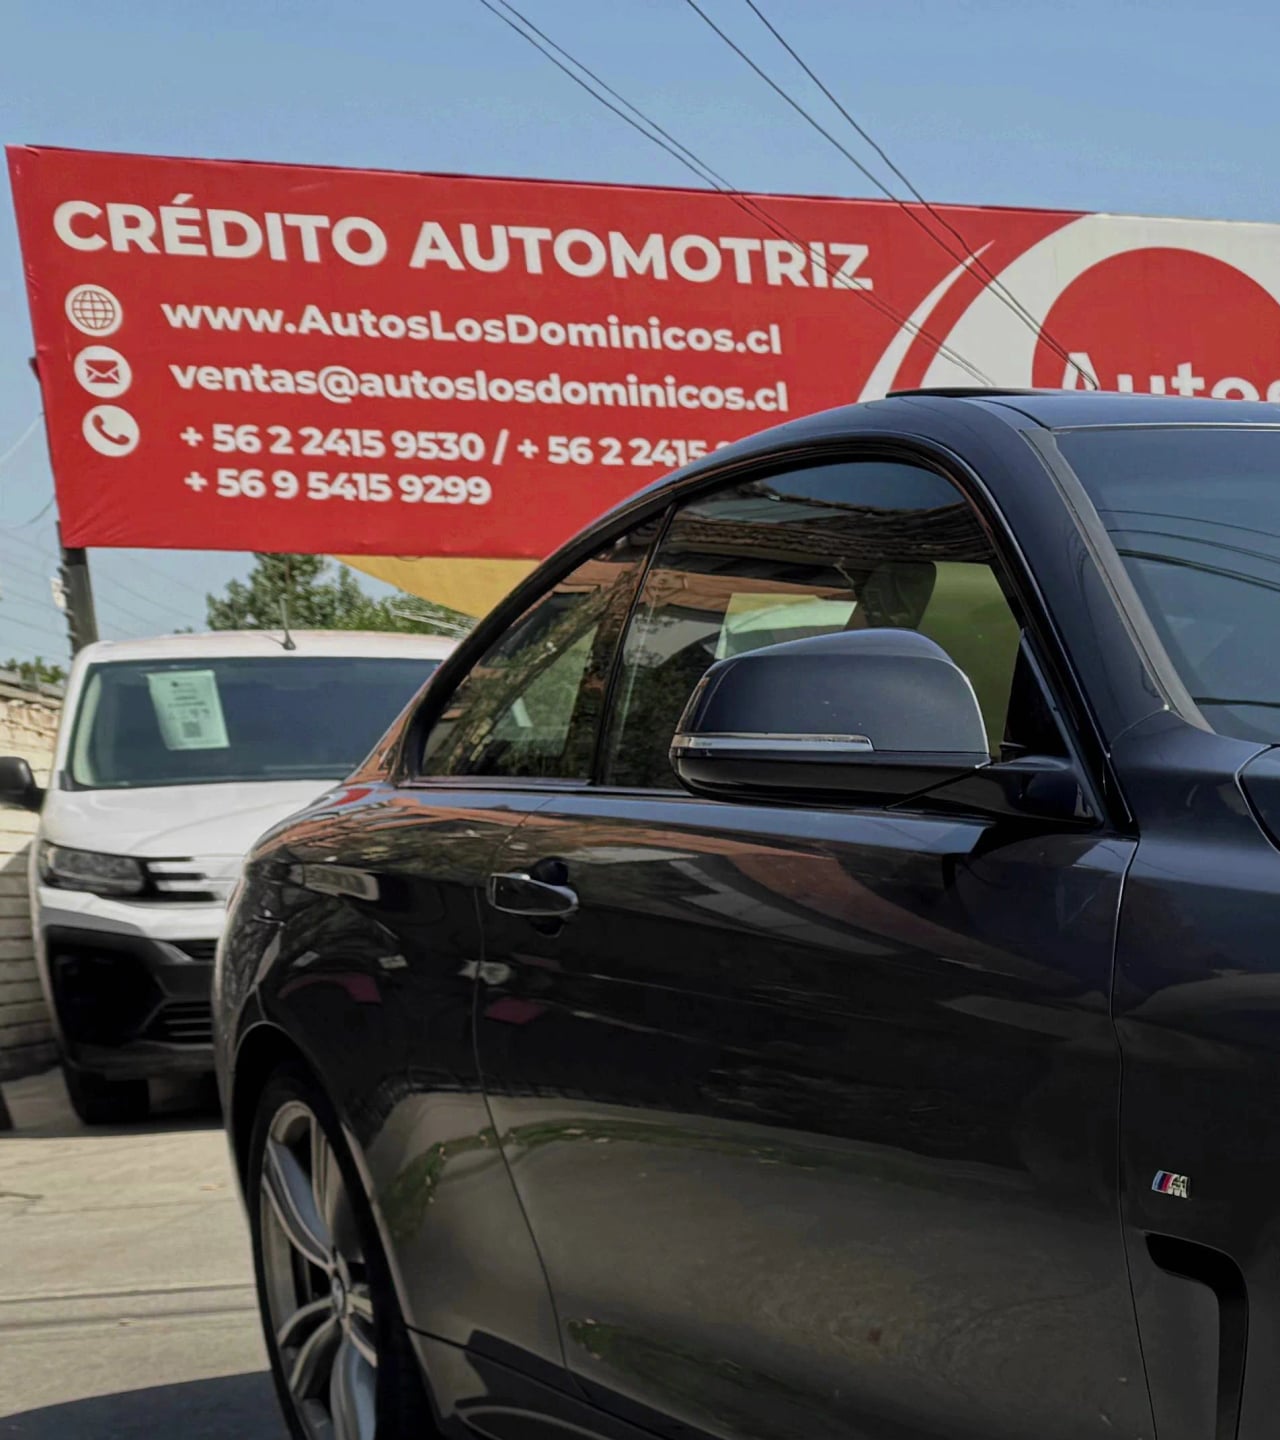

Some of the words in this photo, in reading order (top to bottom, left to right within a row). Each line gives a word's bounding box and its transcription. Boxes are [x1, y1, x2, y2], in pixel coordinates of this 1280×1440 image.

[53, 193, 388, 266] CRÉDITO
[409, 221, 874, 291] AUTOMOTRIZ
[161, 303, 782, 355] www.AutosLosDominicos.cl
[169, 363, 789, 412] ventas@autoslosdominicos.cl
[212, 423, 262, 454] 56
[267, 425, 294, 455] 2
[298, 426, 386, 458] 2415
[391, 430, 485, 461] 9530
[547, 435, 593, 466] 56
[599, 437, 624, 466] 2
[630, 437, 707, 468] 2415
[217, 468, 266, 498] 56
[272, 470, 299, 500] 9
[306, 471, 393, 502] 5415
[398, 474, 492, 505] 9299
